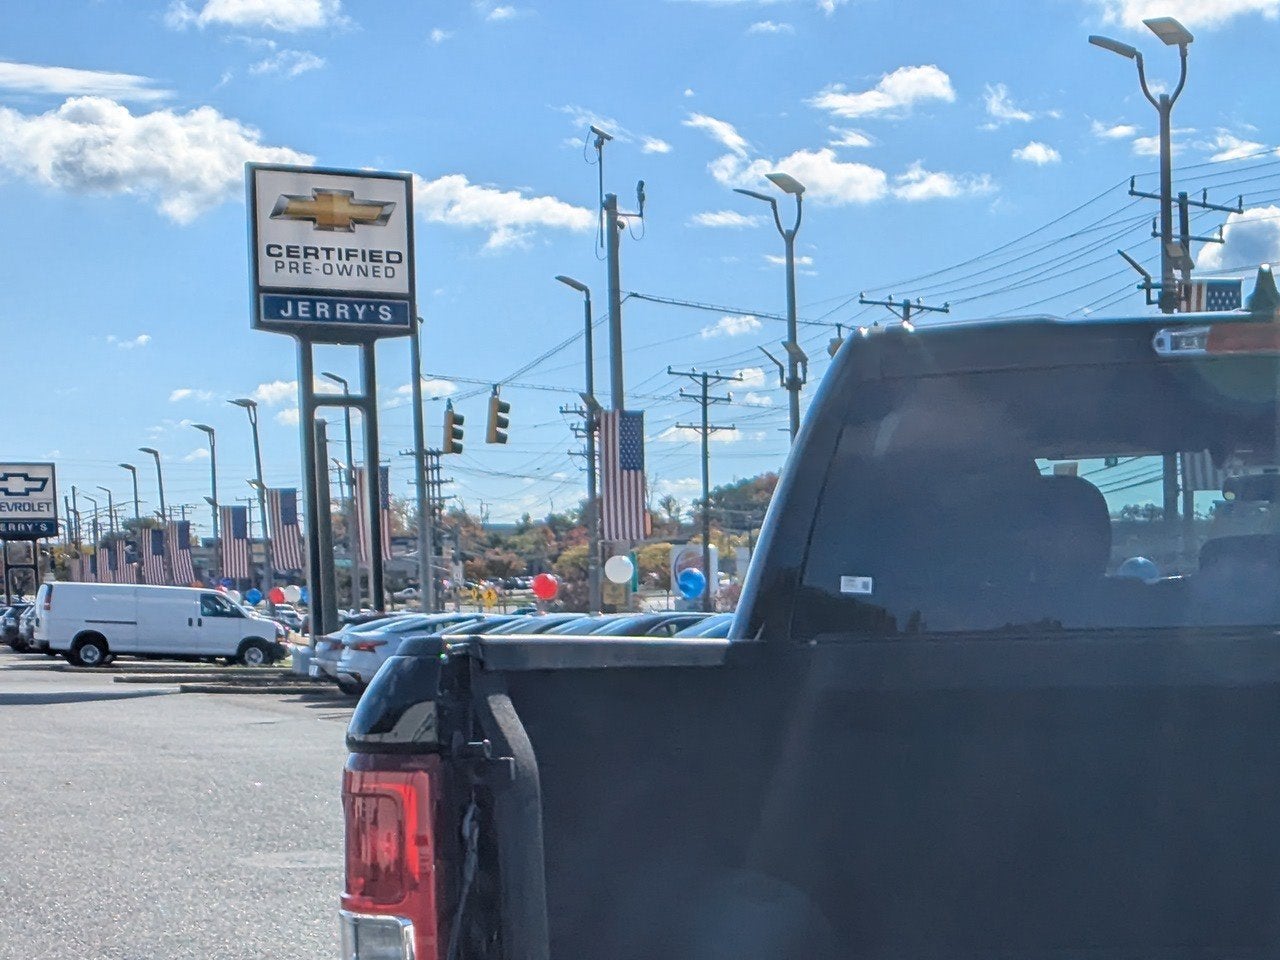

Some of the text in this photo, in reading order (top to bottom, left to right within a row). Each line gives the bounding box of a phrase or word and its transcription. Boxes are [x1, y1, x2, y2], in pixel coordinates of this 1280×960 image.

[266, 244, 403, 264] CERTIFIED
[274, 260, 396, 279] PRE-OWNED
[280, 300, 393, 321] JERRY'S
